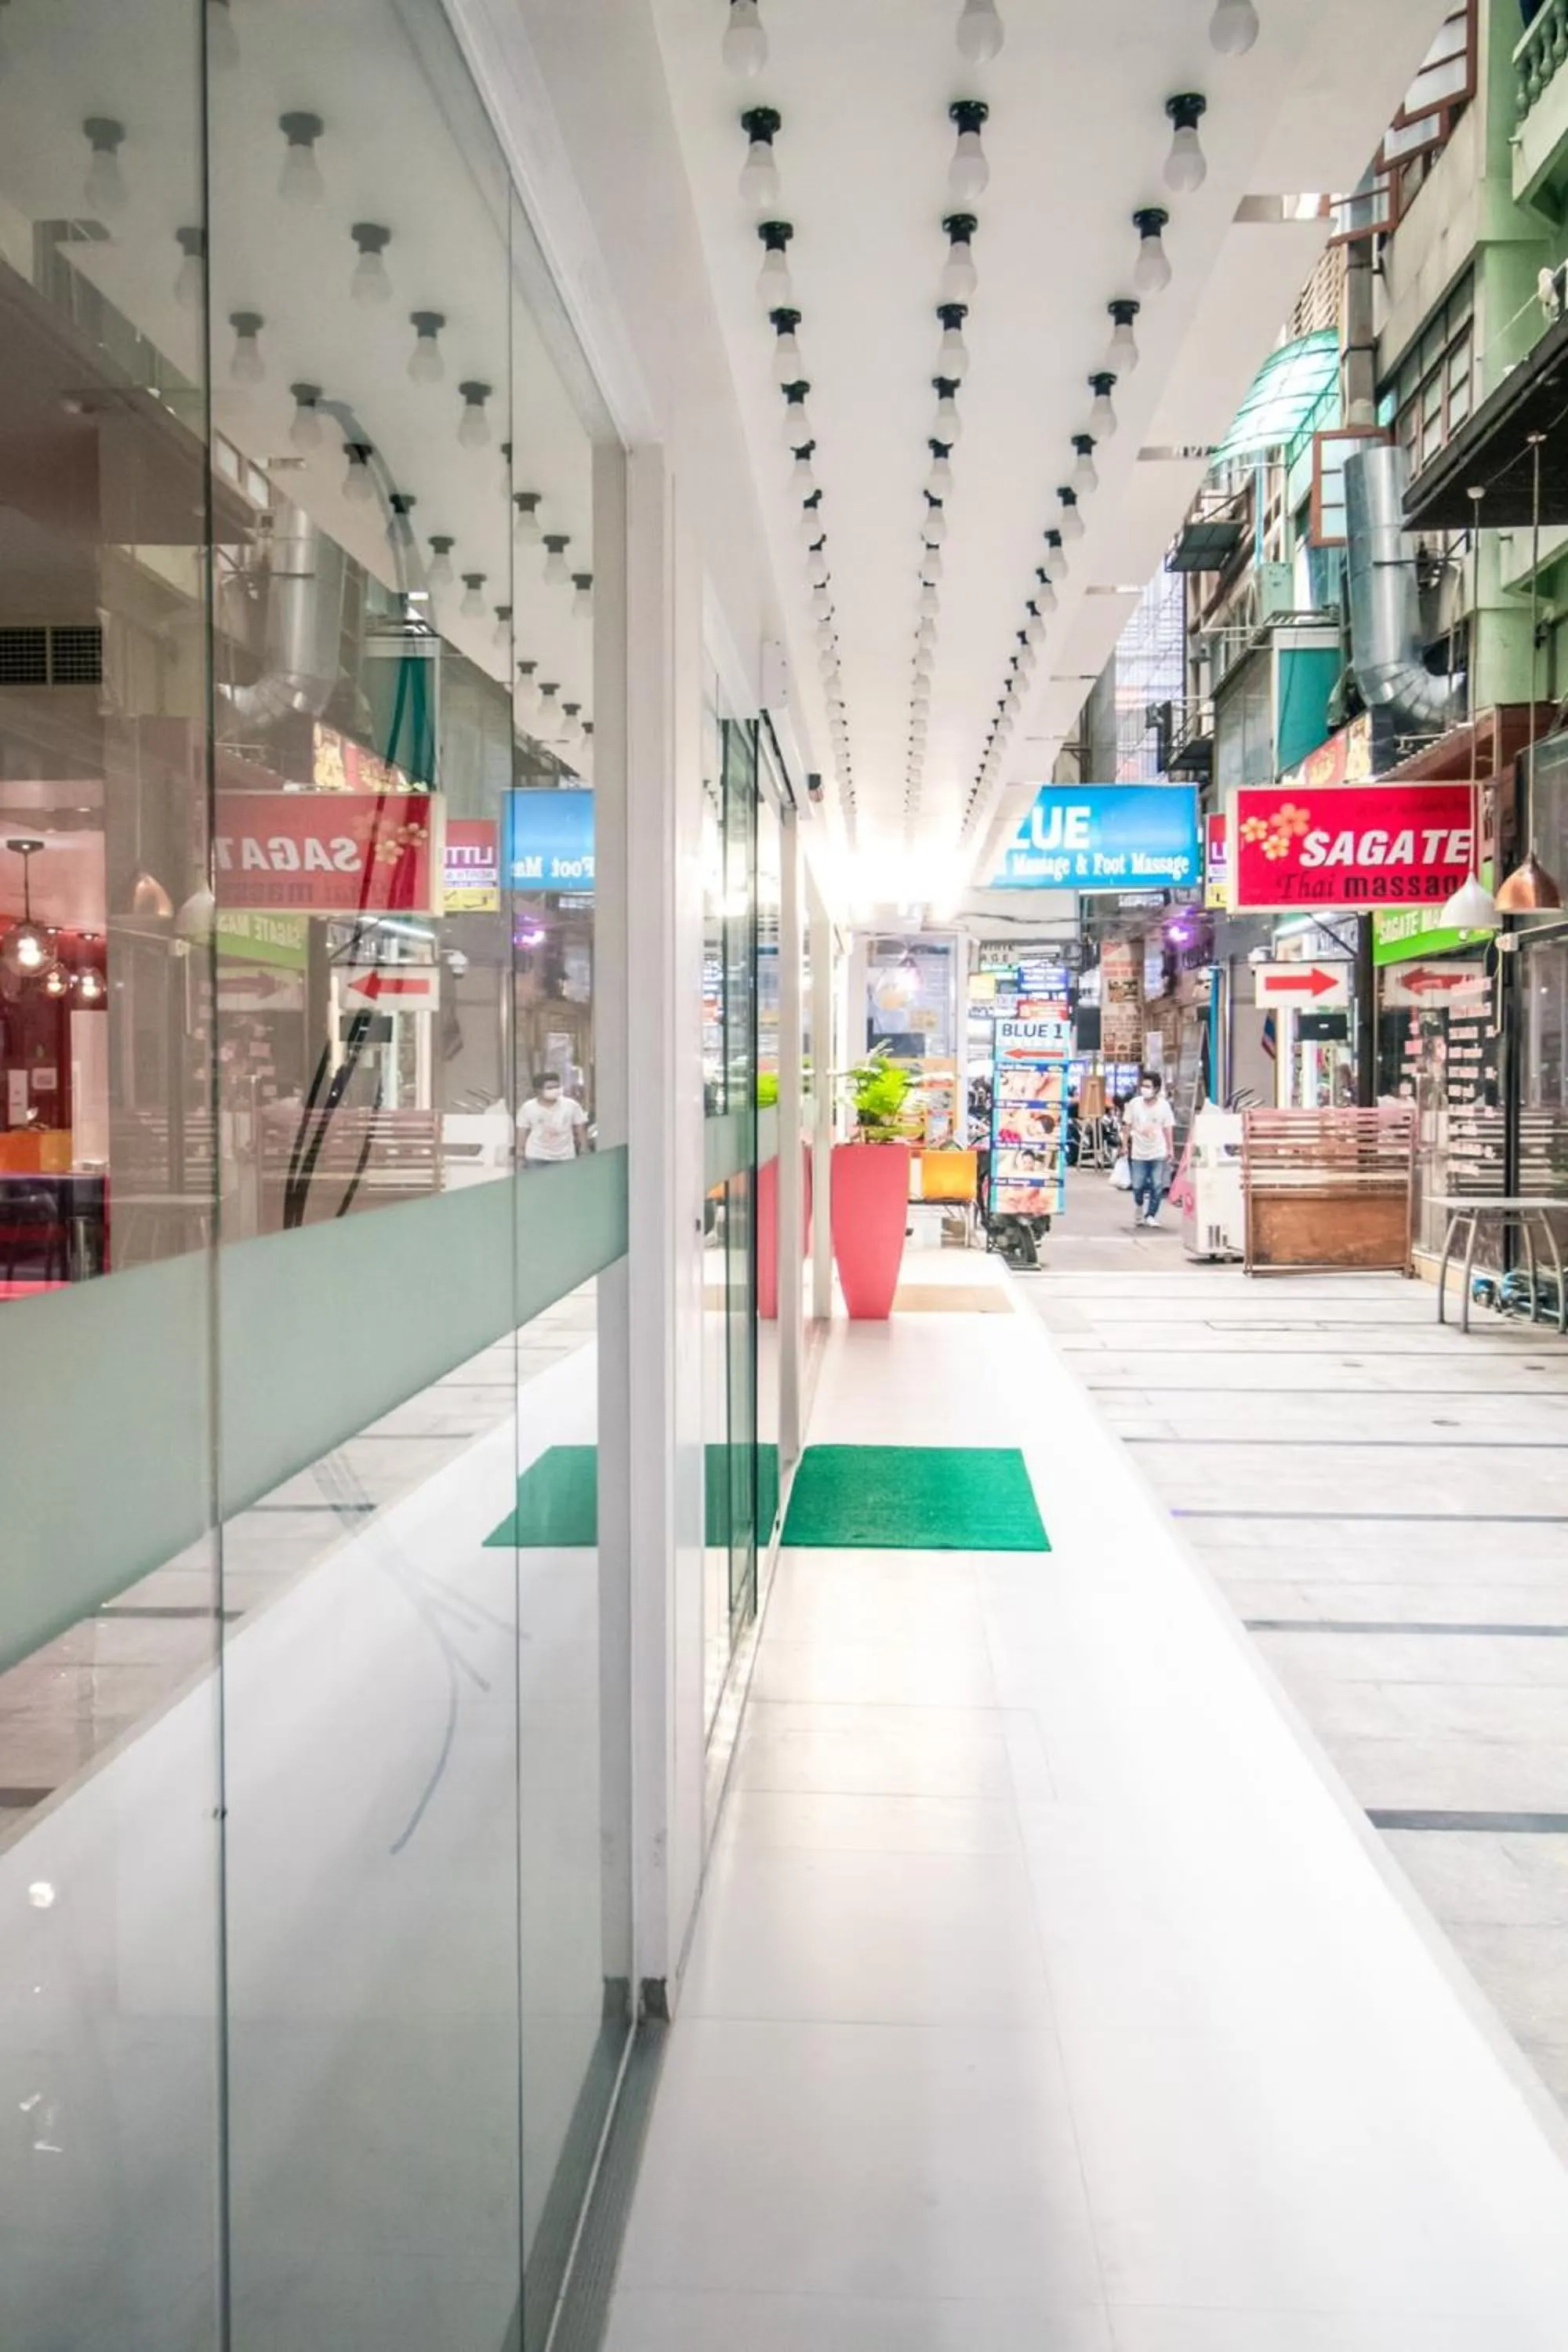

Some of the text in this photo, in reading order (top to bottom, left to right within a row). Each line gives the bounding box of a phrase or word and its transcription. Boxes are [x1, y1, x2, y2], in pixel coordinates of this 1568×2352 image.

[1009, 806, 1091, 850] LUE
[1300, 829, 1472, 867] SAGATE
[1075, 853, 1087, 876] &
[1092, 852, 1125, 877] Foot
[1131, 852, 1190, 881] Massage
[1276, 870, 1468, 899] Thai massag
[1002, 1023, 1064, 1039] BLUE 1
